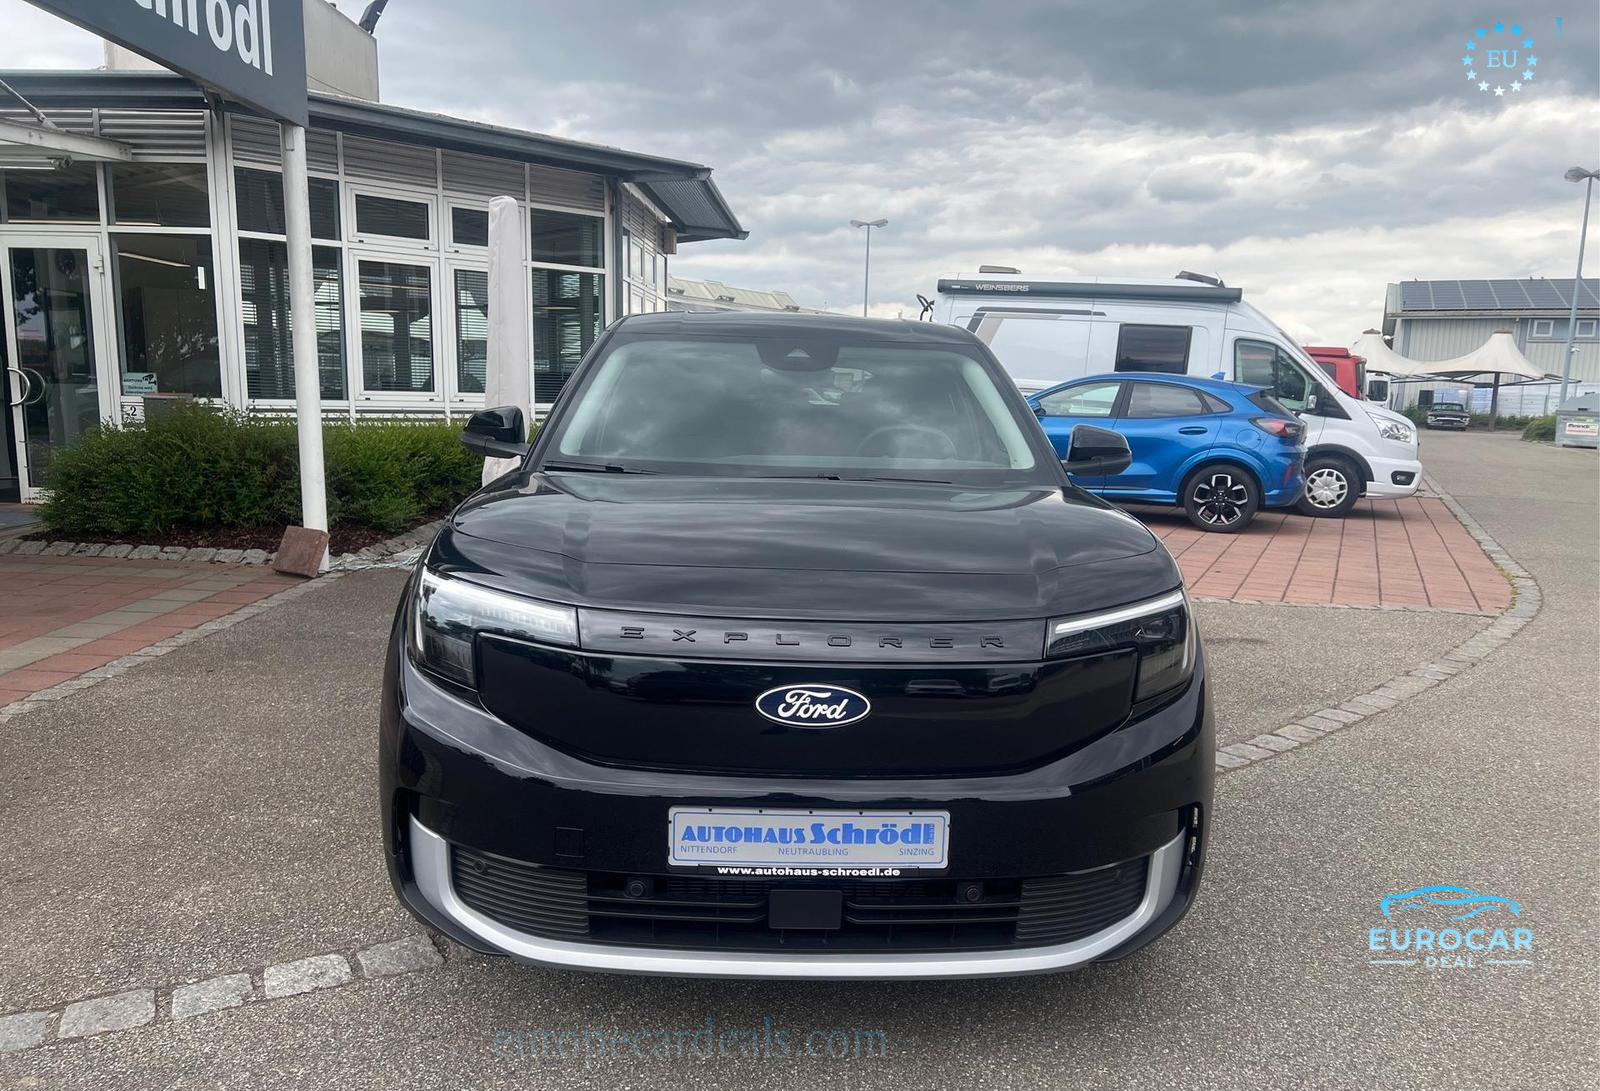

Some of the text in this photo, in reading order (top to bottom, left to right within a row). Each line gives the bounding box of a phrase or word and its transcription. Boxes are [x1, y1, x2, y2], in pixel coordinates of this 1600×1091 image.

[130, 406, 137, 417] 2
[620, 626, 1005, 649] EXPLORER
[777, 689, 849, 719] Ford
[681, 825, 805, 844] AUTOHAUS
[810, 823, 934, 845] Schrödl
[680, 845, 935, 856] NITTENDORF NEUTRAUBLING SINZING
[717, 866, 901, 877] www.autohaus-schroedl.de
